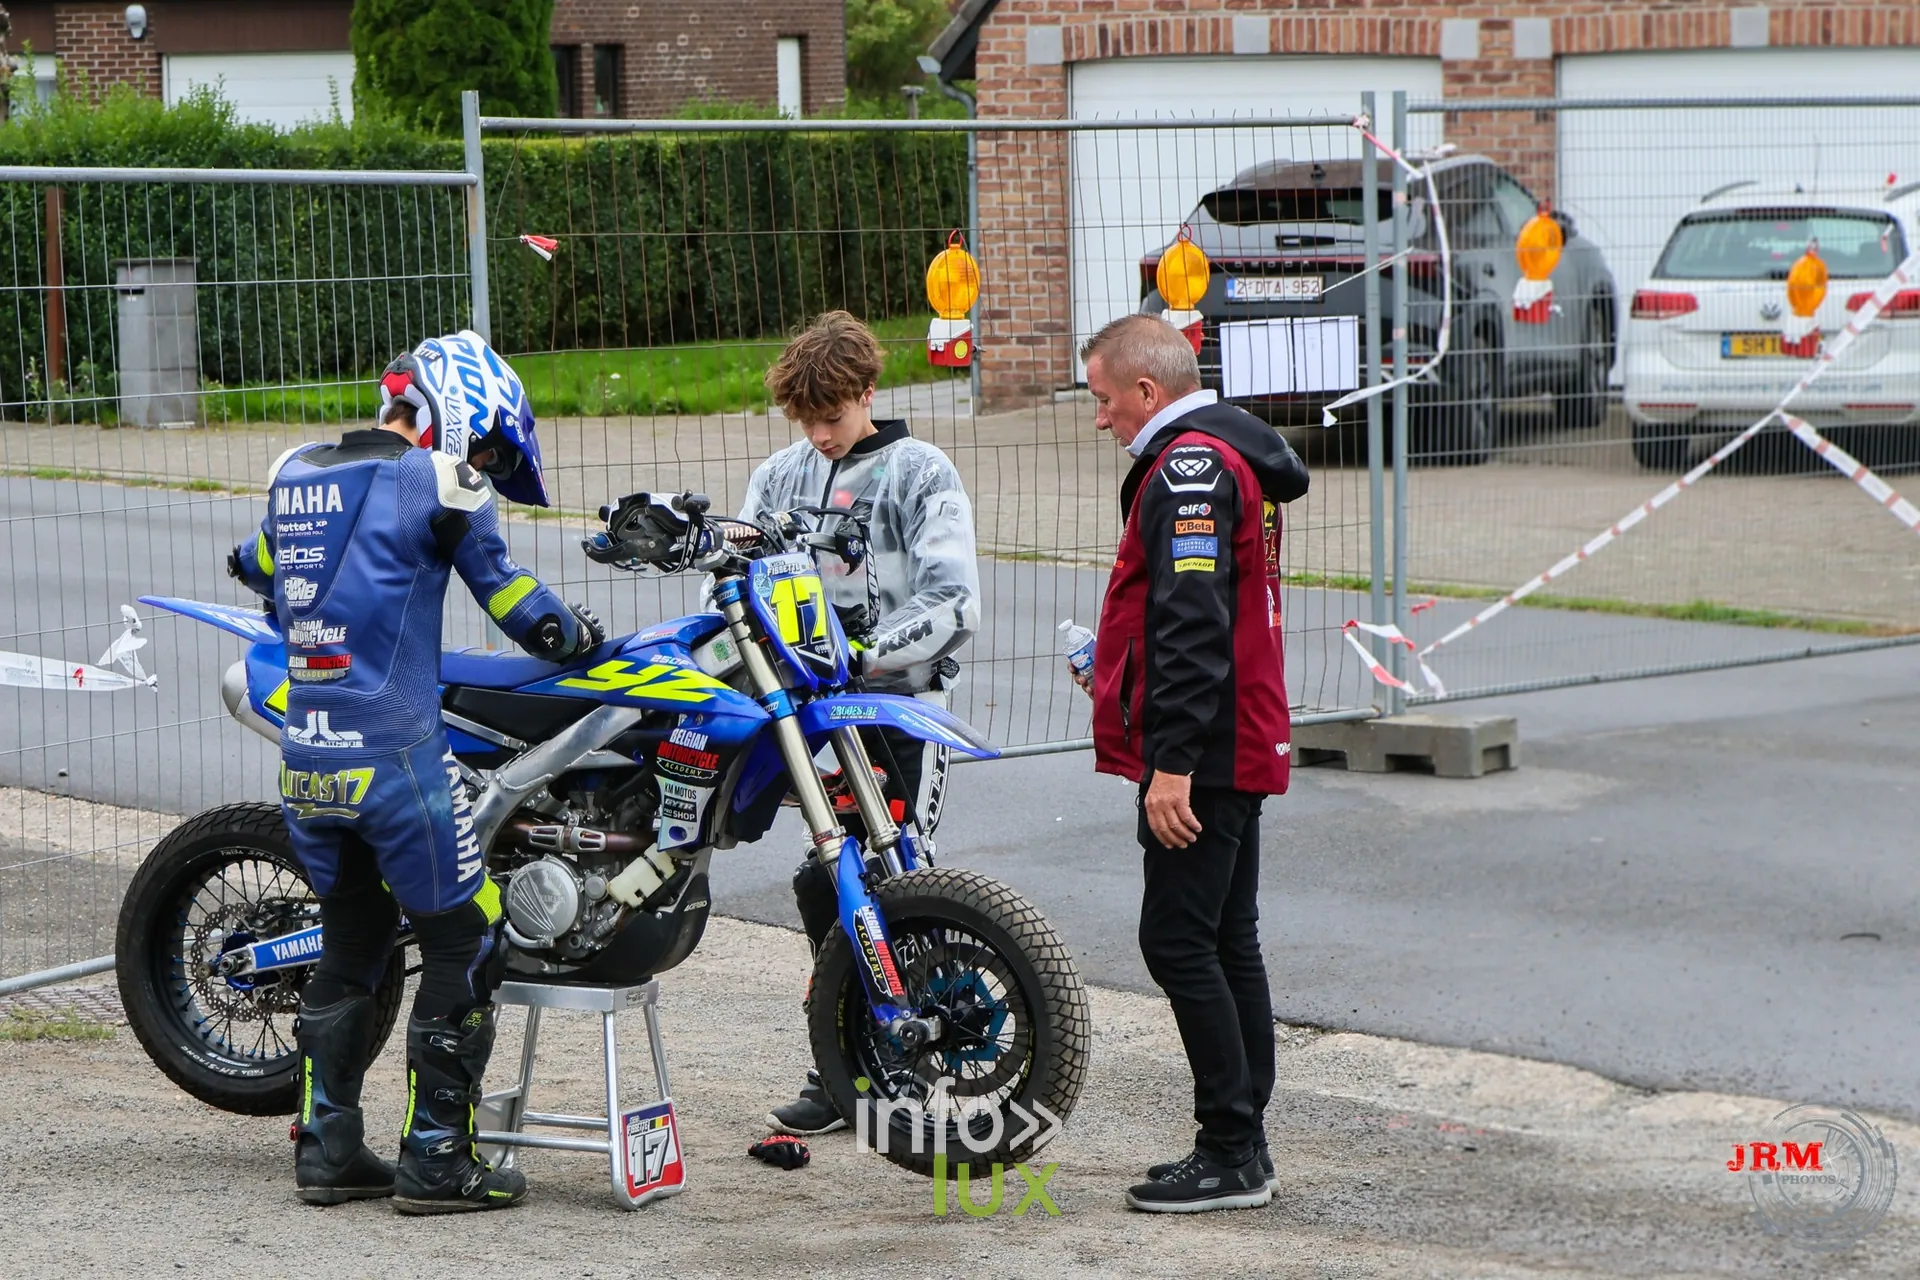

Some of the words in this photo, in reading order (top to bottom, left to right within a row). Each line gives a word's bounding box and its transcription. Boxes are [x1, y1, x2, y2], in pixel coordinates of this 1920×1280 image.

[276, 484, 344, 515] MAHA
[1178, 504, 1199, 516] elf
[1187, 522, 1212, 532] Beta
[770, 576, 828, 646] 17
[669, 728, 708, 751] BELGIAN
[657, 741, 720, 769] MOTORCYCLE
[665, 762, 702, 776] ACADEMY
[674, 786, 697, 799] MOTOS
[442, 744, 484, 884] YAMAHA
[673, 810, 696, 820] SHOP
[861, 906, 884, 940] BELGIAN
[271, 934, 324, 962] YAMAHA
[857, 925, 883, 980] ACADEMY
[874, 941, 905, 996] MOTORCYCLE
[632, 1126, 670, 1187] 17
